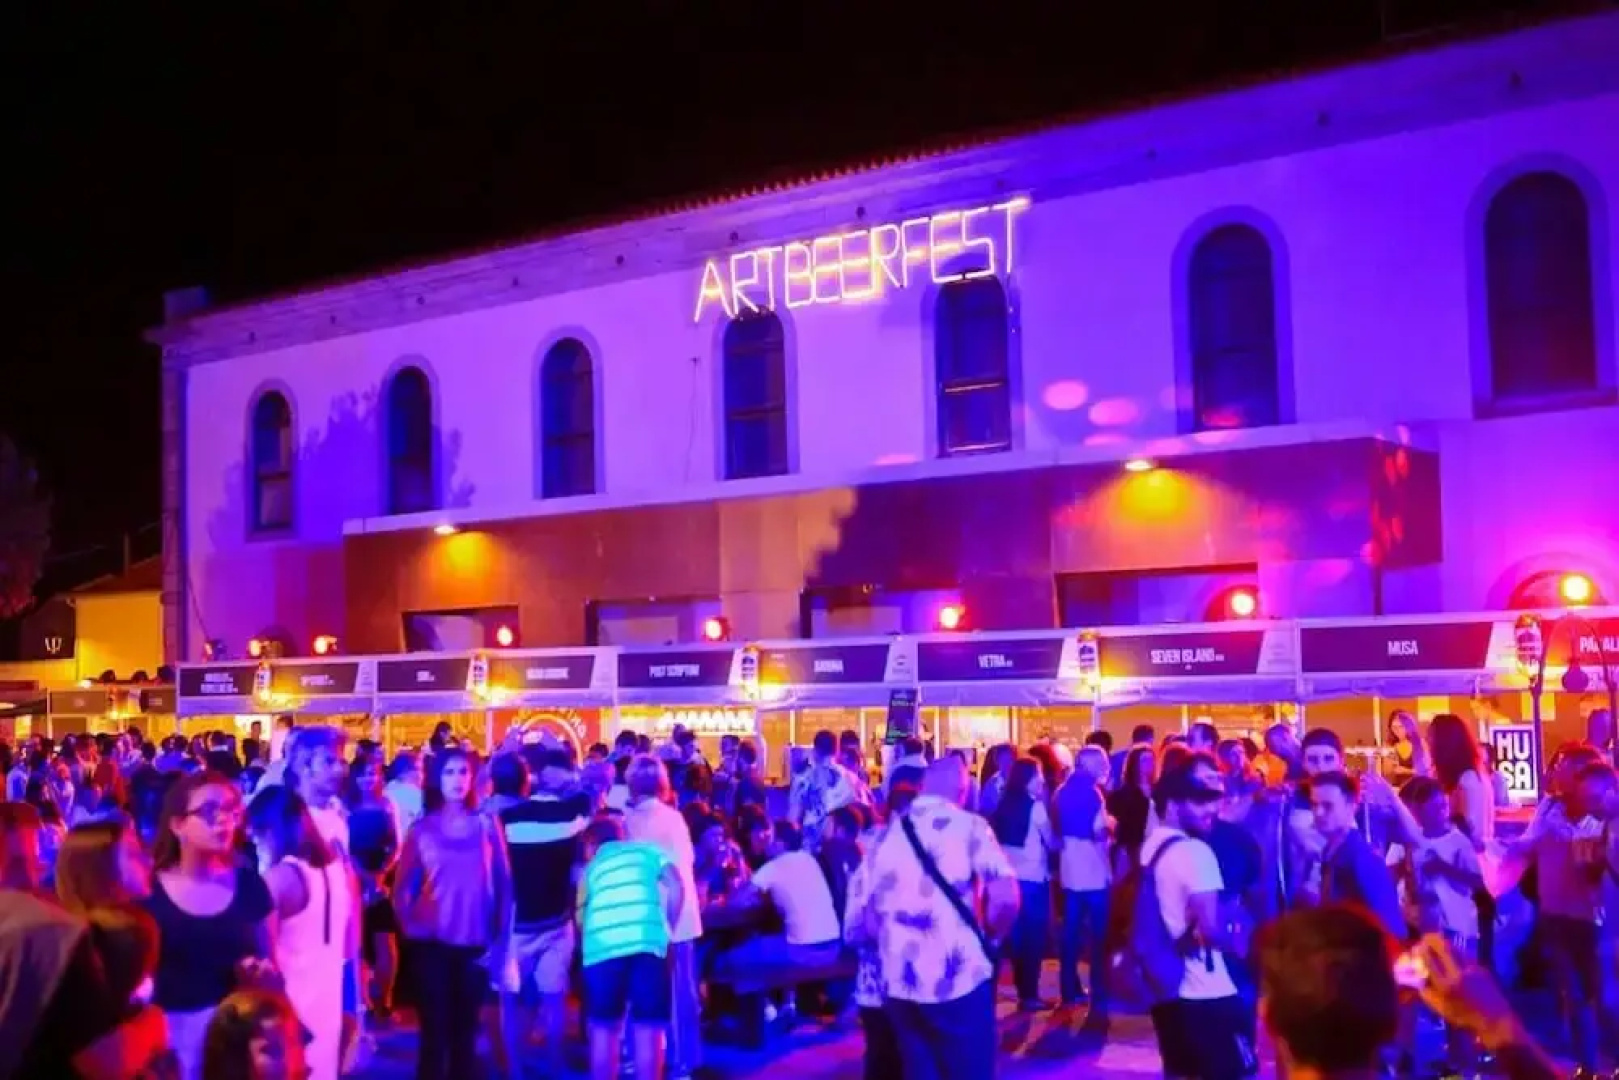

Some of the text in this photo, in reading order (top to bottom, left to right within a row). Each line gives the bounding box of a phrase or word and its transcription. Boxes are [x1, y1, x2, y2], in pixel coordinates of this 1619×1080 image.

[694, 196, 1031, 322] ARTBEERFEST
[1150, 649, 1180, 664] SEVEN
[1182, 647, 1215, 662] ISLAND
[1387, 640, 1419, 655] MUSA
